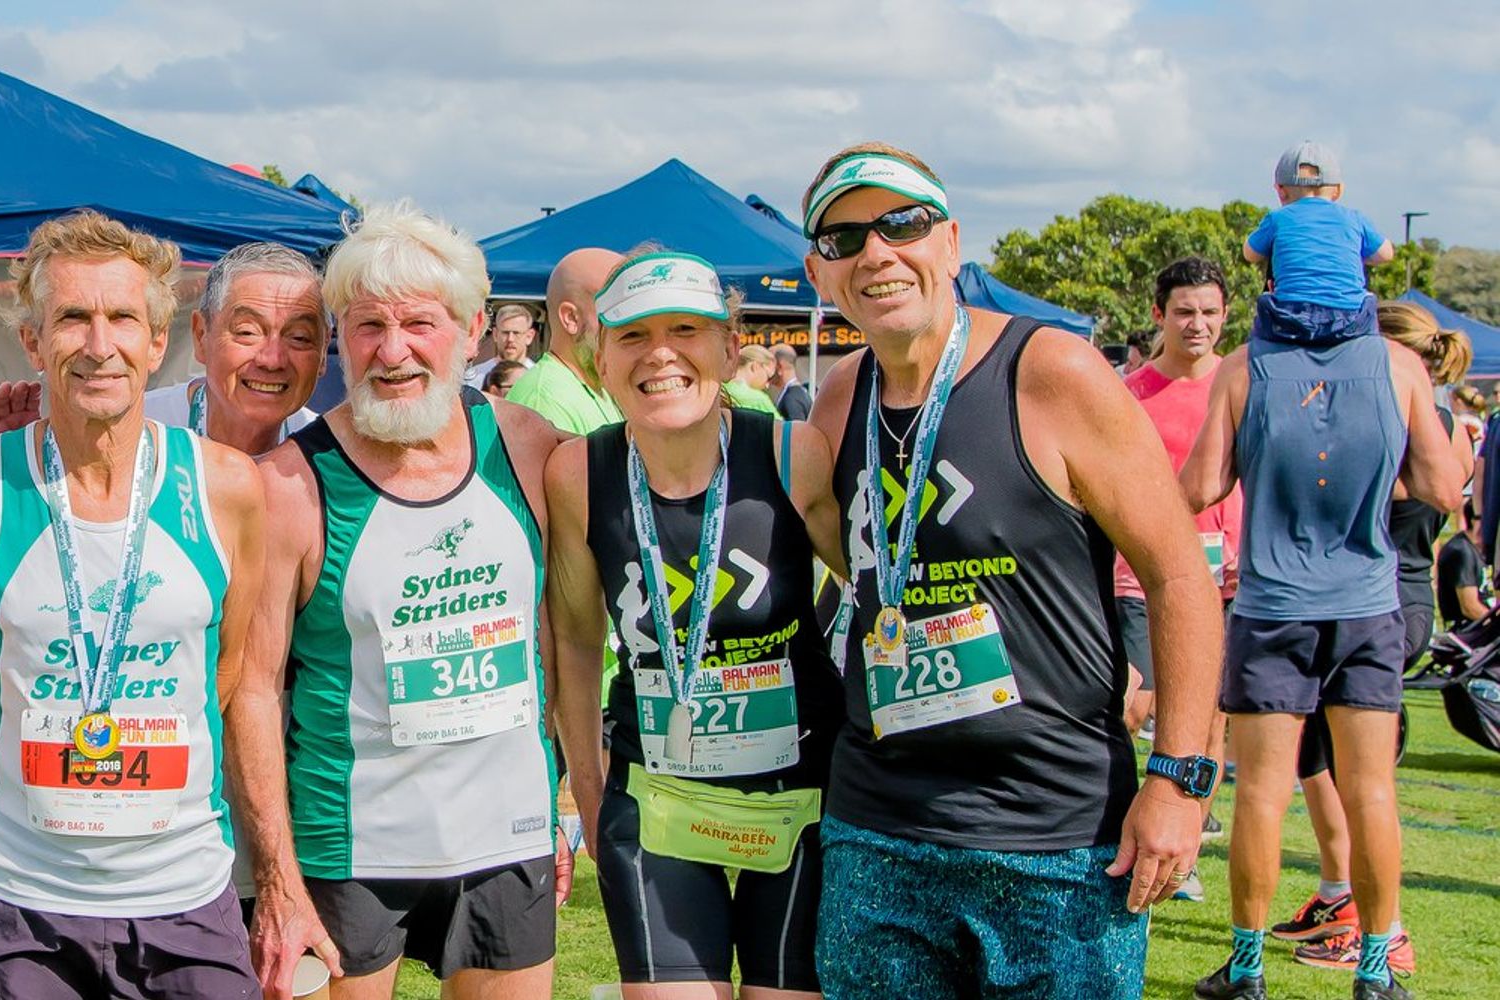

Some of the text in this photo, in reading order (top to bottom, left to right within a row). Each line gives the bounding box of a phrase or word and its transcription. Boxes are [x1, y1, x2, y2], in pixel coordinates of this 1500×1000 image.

[771, 331, 830, 345] Pubc
[174, 464, 199, 543] 2XU
[928, 556, 1017, 582] BEYOND
[401, 562, 503, 600] Sydney
[391, 589, 508, 628] Striders
[472, 616, 517, 637] BALMAIN
[437, 628, 471, 645] belle
[474, 633, 495, 649] FUN
[927, 630, 953, 647] FUN
[430, 650, 499, 698] 346
[722, 663, 781, 681] BALMAIN
[894, 649, 962, 700] 228
[723, 675, 781, 692] FUN RUN
[687, 695, 749, 735] 227
[118, 718, 177, 731] BALMAIN
[150, 731, 177, 743] RUN
[416, 726, 475, 741] DROP BAG TAG
[667, 762, 724, 773] DROP BAG TAG
[775, 753, 790, 765] 227
[43, 818, 105, 832] DROP BAG TAG
[690, 823, 777, 846] NARRABEEN
